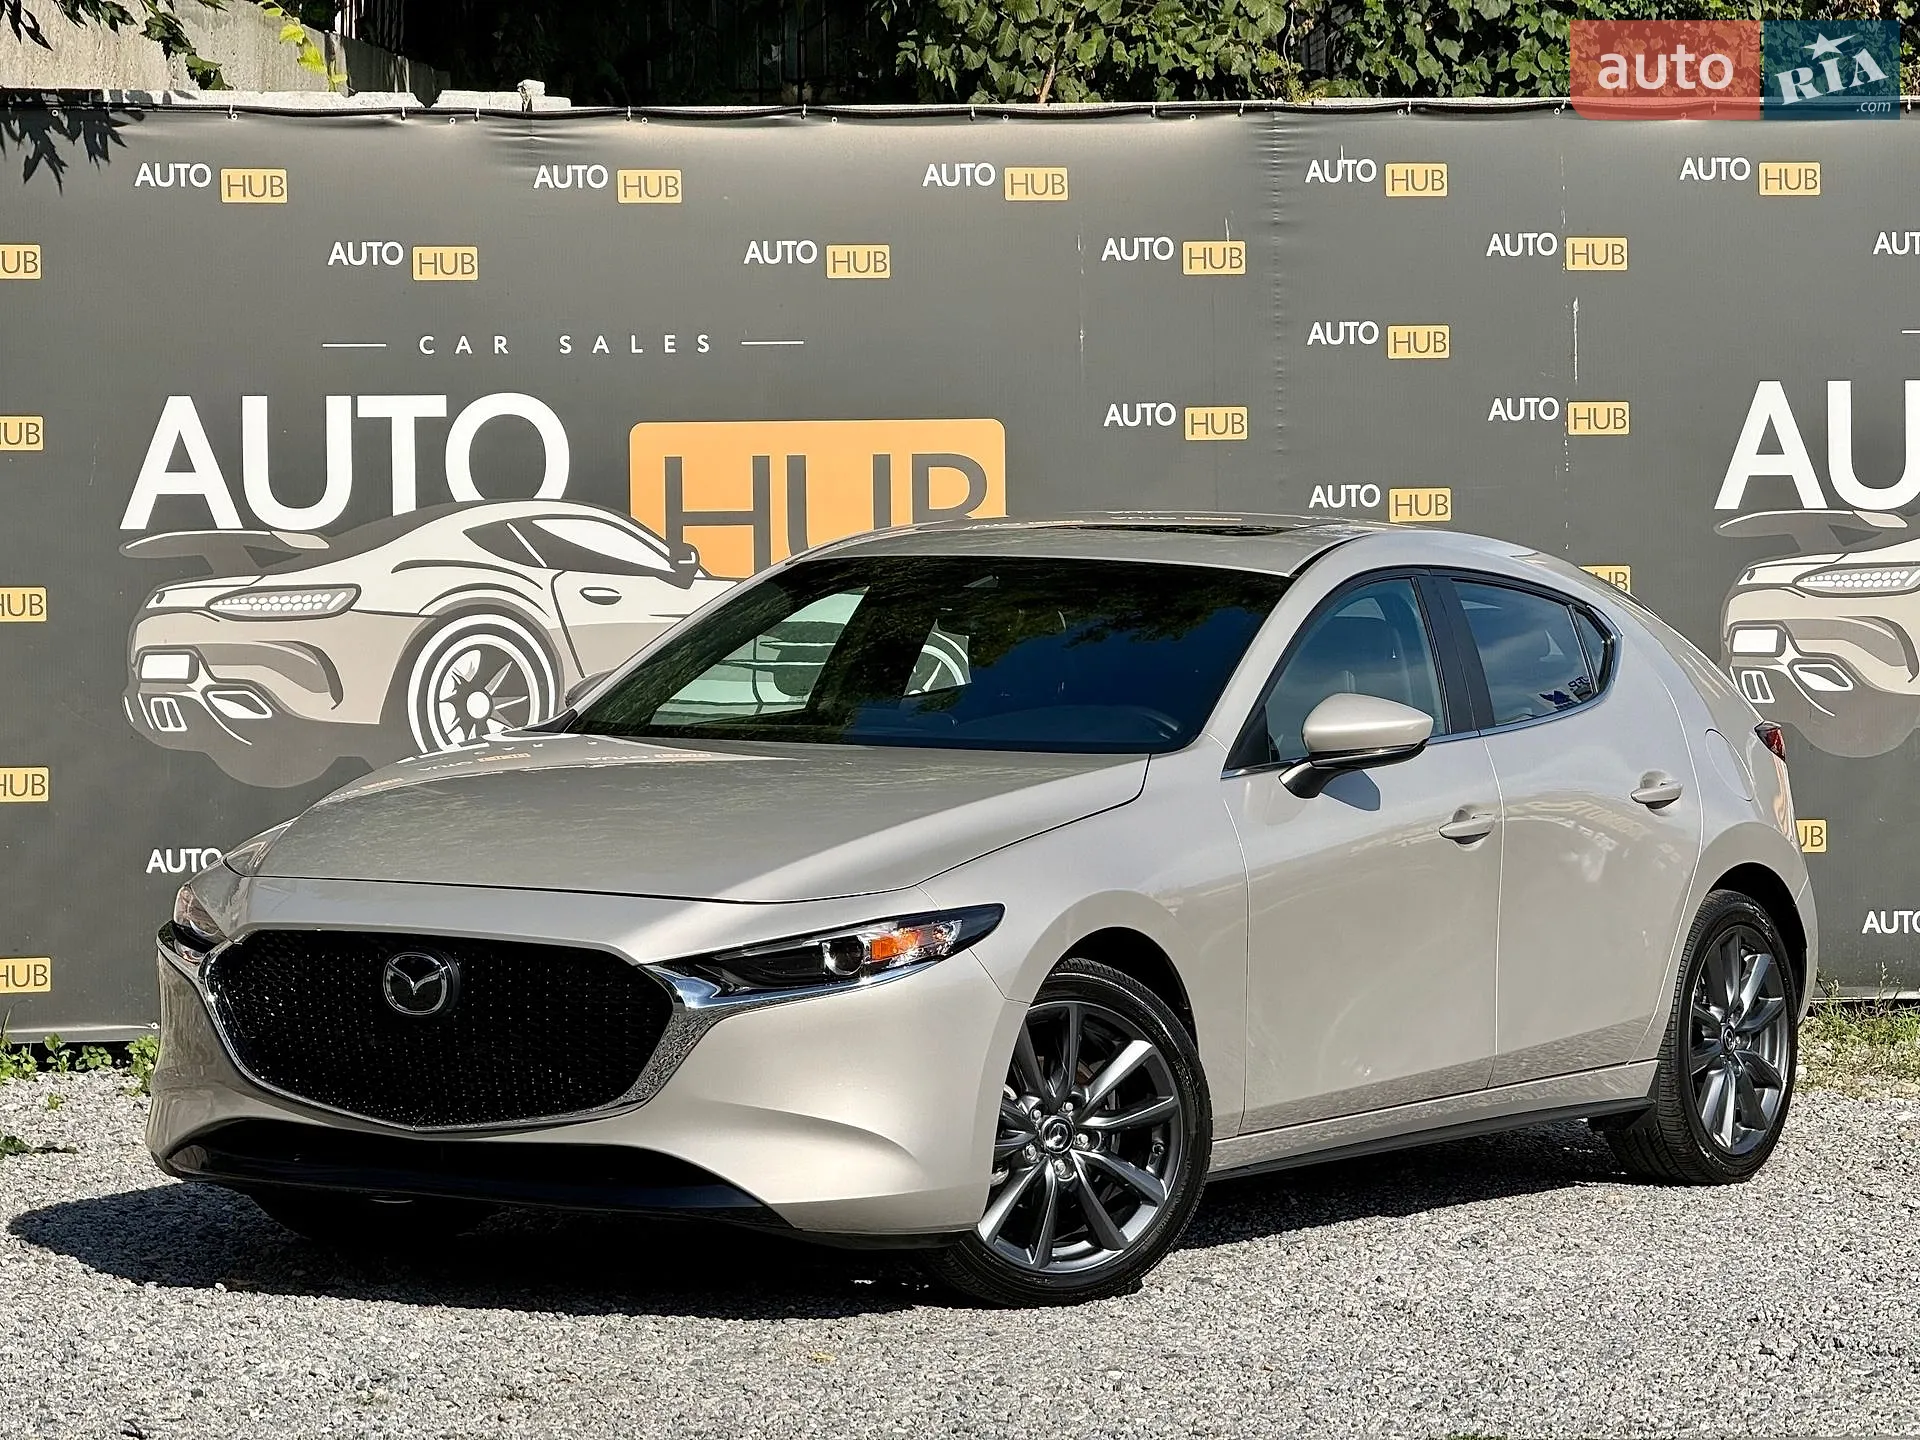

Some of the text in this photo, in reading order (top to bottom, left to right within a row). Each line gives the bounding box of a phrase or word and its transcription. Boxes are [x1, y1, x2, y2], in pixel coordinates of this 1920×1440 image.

[134, 163, 284, 198] AUTO HUB
[533, 164, 678, 198] AUTO HUB
[922, 162, 1064, 196] AUTO HUB
[1304, 159, 1443, 192] AUTO HUB
[1679, 156, 1816, 191] AUTO HUB
[327, 241, 474, 276] AUTO HUB
[743, 239, 887, 274] AUTO HUB
[1101, 236, 1242, 270] AUTO HUB
[1485, 232, 1623, 266] AUTO HUB
[1872, 231, 1920, 256] AUT
[1, 250, 37, 274] UB
[419, 334, 711, 355] CAR SALES
[1306, 320, 1446, 354] AUTO HUB
[1103, 402, 1245, 436] AUTO HUB
[1487, 396, 1625, 430] AUTO HUB
[0, 422, 41, 446] UB
[1713, 379, 1920, 511] AU
[120, 392, 571, 531] AUTO
[1308, 483, 1447, 517] AUTO HUB
